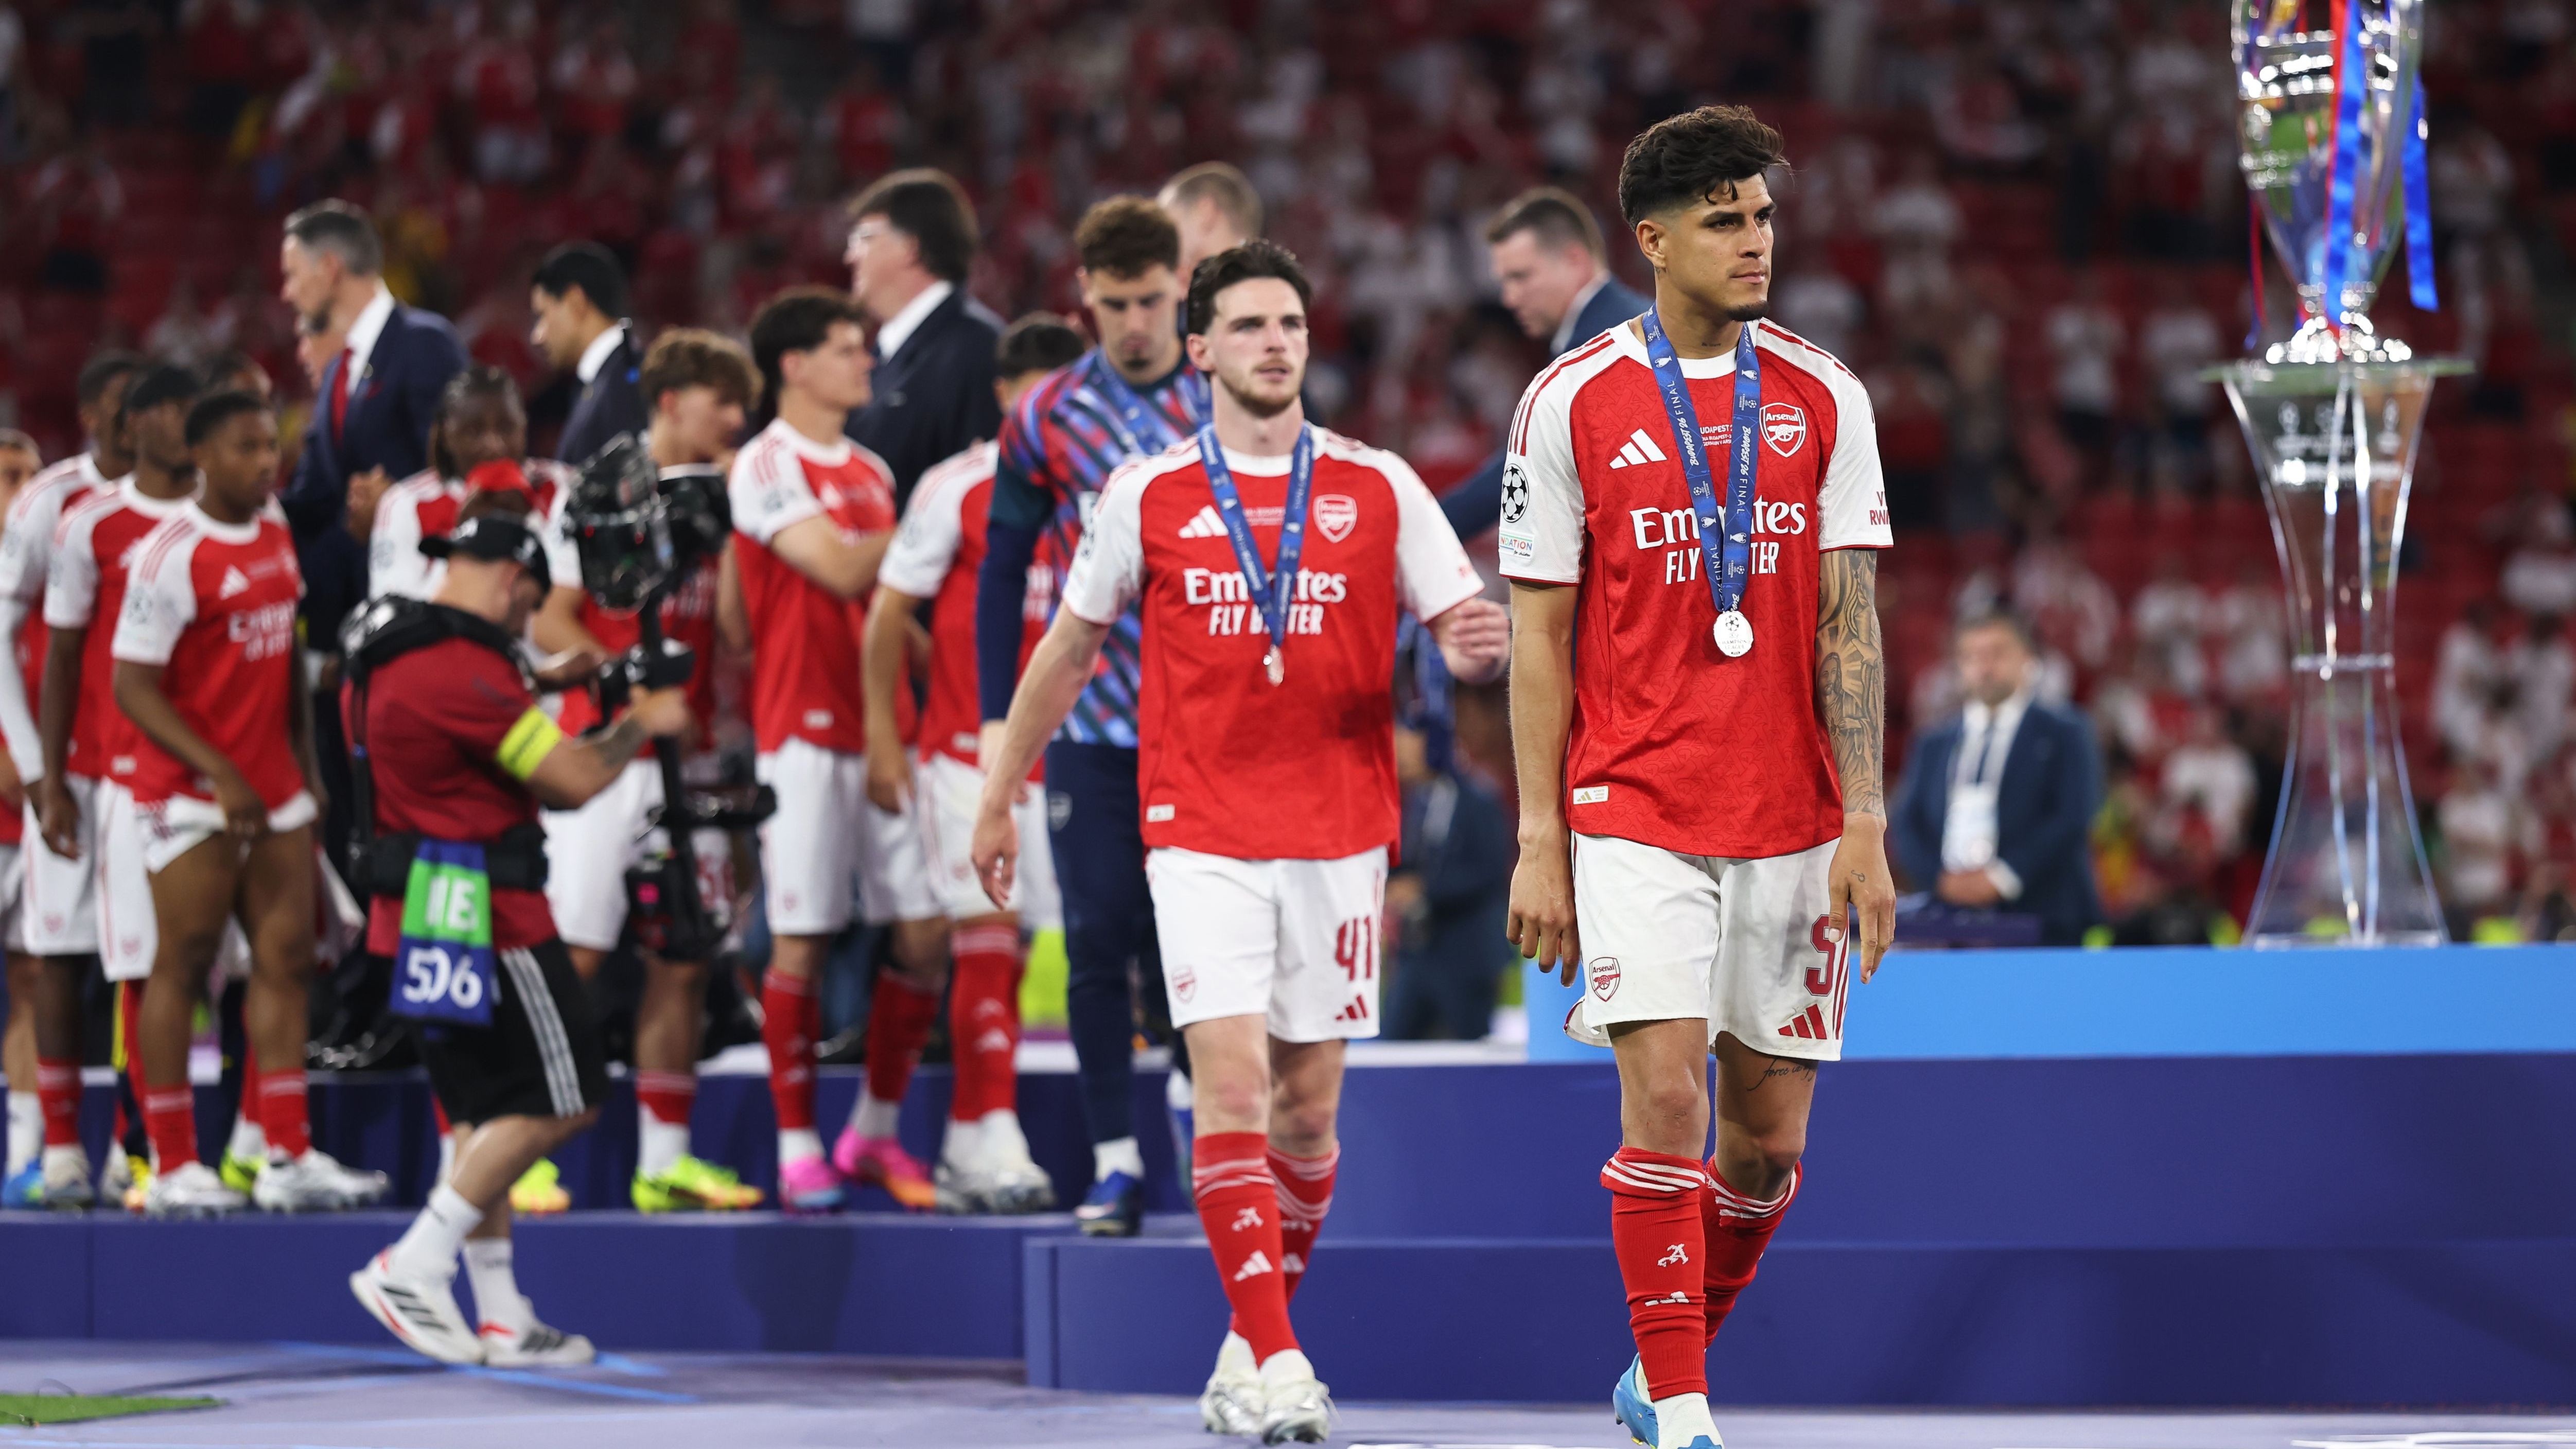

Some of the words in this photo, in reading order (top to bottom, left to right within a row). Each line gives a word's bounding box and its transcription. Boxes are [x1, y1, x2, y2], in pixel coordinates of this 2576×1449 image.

[1667, 380, 1684, 415] FINAL
[1700, 424, 1729, 434] UDAPEST
[1765, 412, 1799, 422] Arsenal
[1737, 478, 1748, 514] FINAL
[1629, 495, 1806, 550] Emtes
[1666, 547, 1701, 585] FLY
[1208, 604, 1247, 636] FLY
[1335, 915, 1372, 982] 41
[1592, 963, 1615, 974] Arsenal
